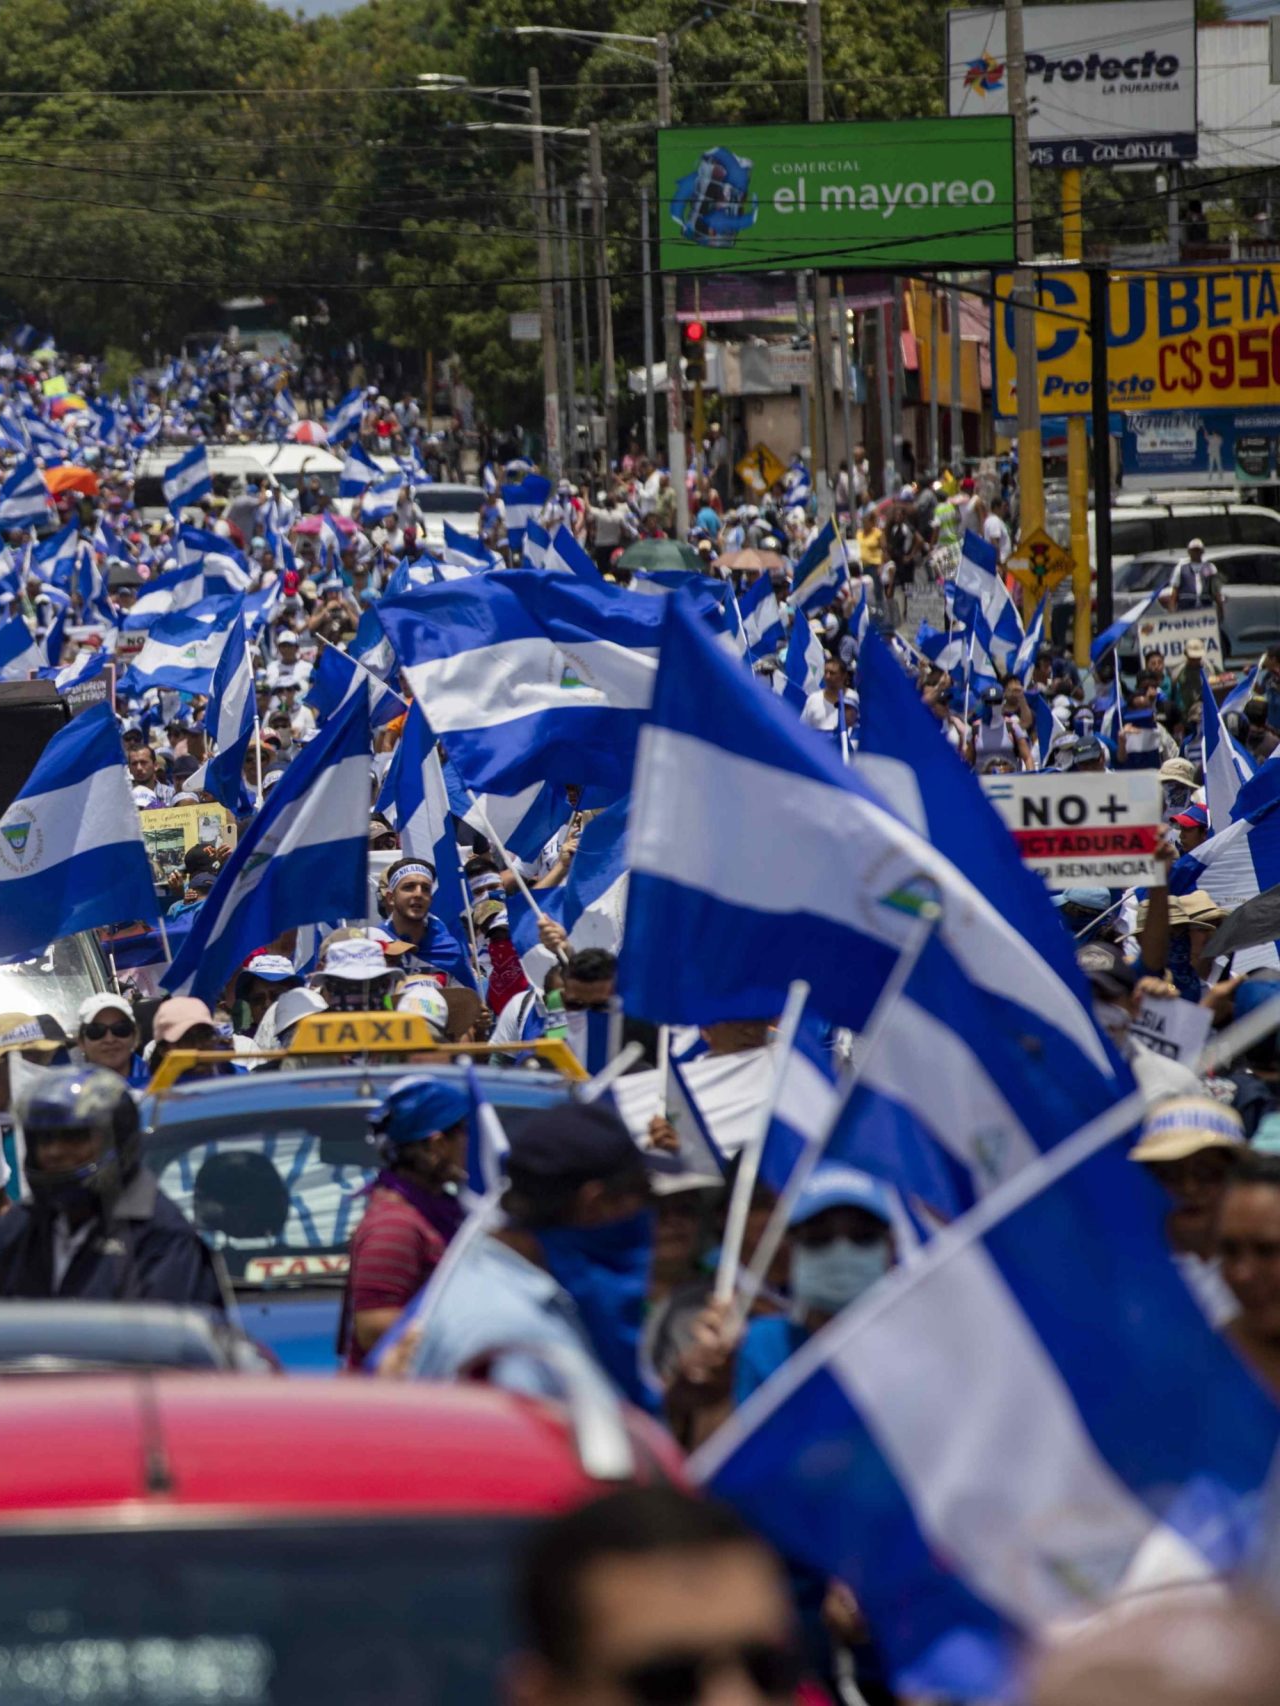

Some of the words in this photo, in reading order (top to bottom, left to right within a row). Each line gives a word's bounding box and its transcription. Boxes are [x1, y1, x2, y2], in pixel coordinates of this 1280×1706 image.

[1024, 50, 1179, 84] Protecto
[1102, 85, 1116, 95] LA
[1120, 81, 1180, 94] DURADERA
[1062, 147, 1084, 162] EL
[1092, 143, 1180, 161] COLONIAL
[772, 160, 862, 174] COMERCIAL
[773, 177, 806, 213] el
[820, 178, 996, 218] mayoreo
[1004, 268, 1280, 363] CUBETA
[1043, 375, 1157, 398] Proecto
[1142, 637, 1219, 657] CUBA
[1022, 794, 1089, 827] NO
[1097, 794, 1128, 823] +
[1022, 832, 1144, 853] ICTADURA
[313, 1020, 413, 1045] TAXI
[255, 1257, 348, 1278] TAX
